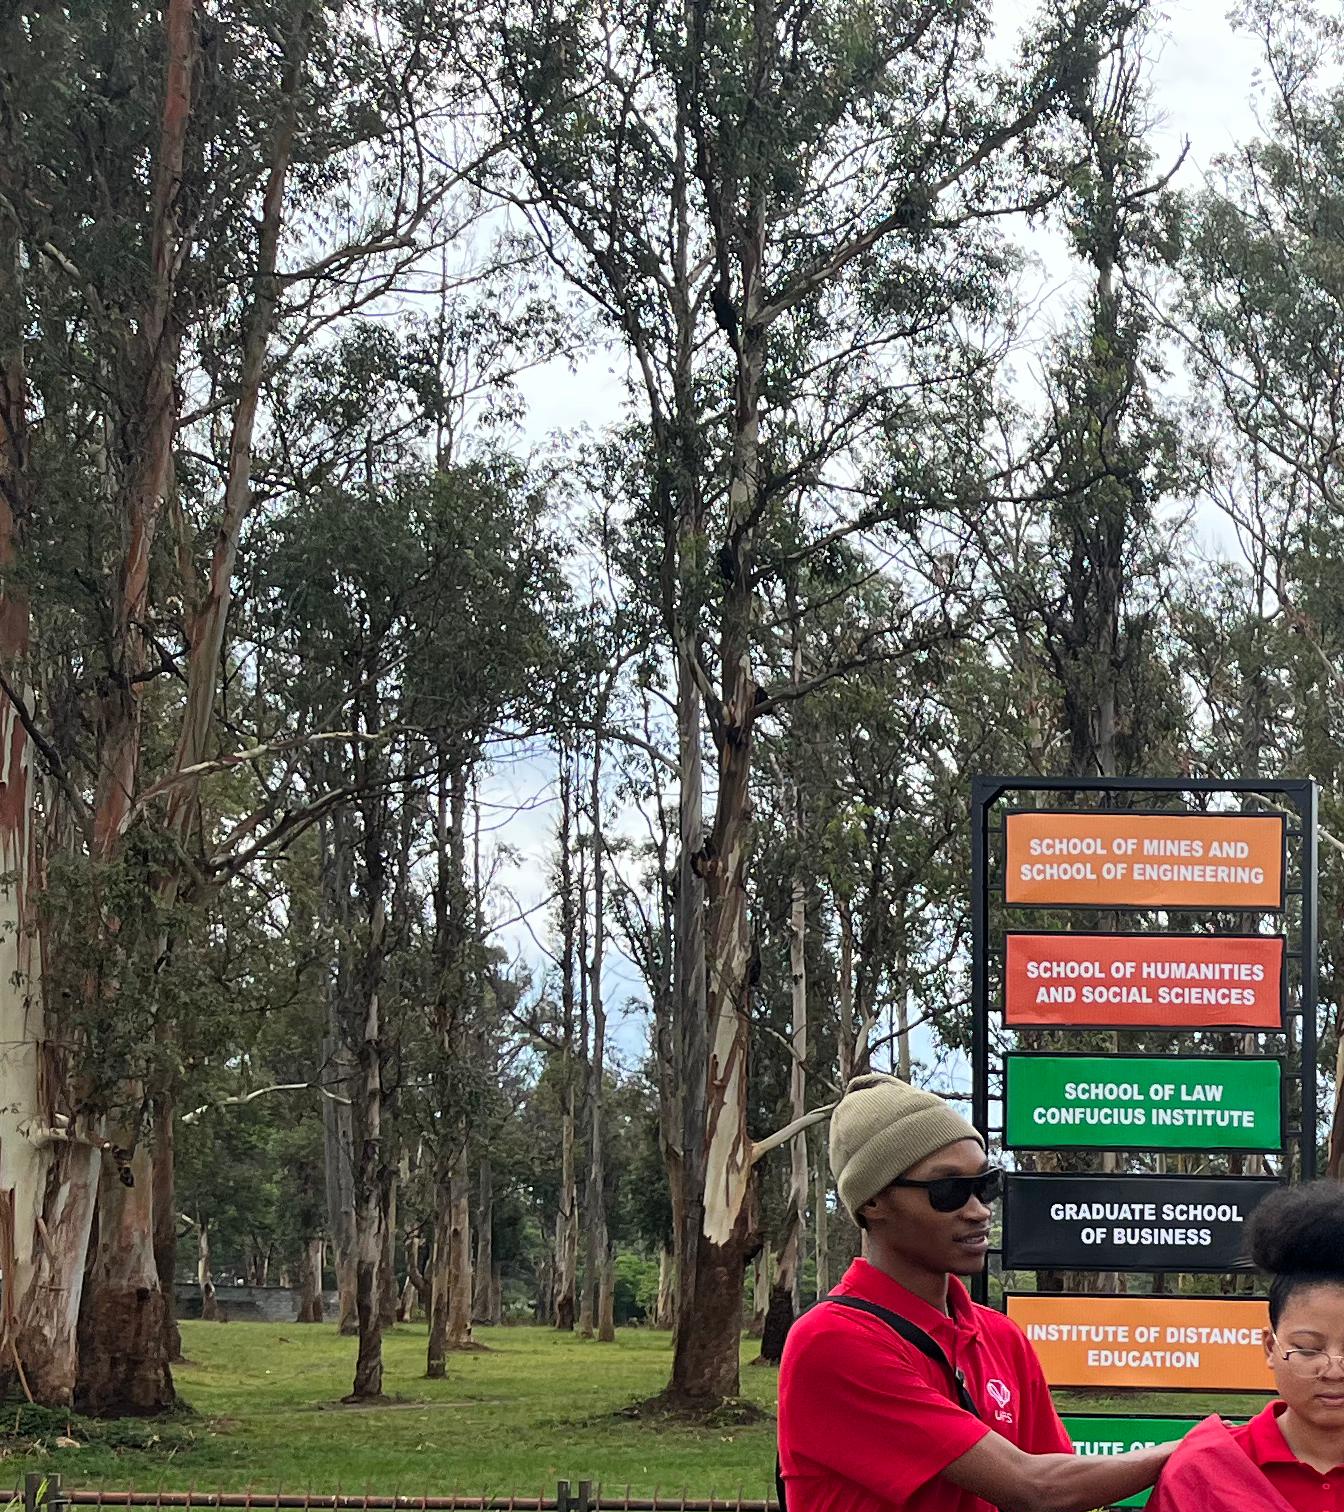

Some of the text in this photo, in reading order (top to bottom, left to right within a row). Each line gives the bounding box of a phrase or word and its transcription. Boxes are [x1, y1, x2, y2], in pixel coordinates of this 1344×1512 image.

[1029, 838, 1249, 859] SCHOOL OF MINES AND
[1020, 863, 1264, 884] SCHOOL OF ENGINEERING
[1026, 961, 1265, 982] SCHOOL OF HUMANITIES
[1035, 986, 1256, 1006] AND SOCIAL SCIENCES
[1064, 1082, 1224, 1102] SCHOOL OF LAW
[1033, 1107, 1255, 1128] CONFUCIUS INSTITUTE
[1050, 1203, 1243, 1222] GRADUATE SCHOOL
[1080, 1227, 1212, 1246] OF BUSINESS
[1027, 1323, 1263, 1346] INSTITUTE OF DISTANCE
[1087, 1350, 1200, 1368] EDUCATION
